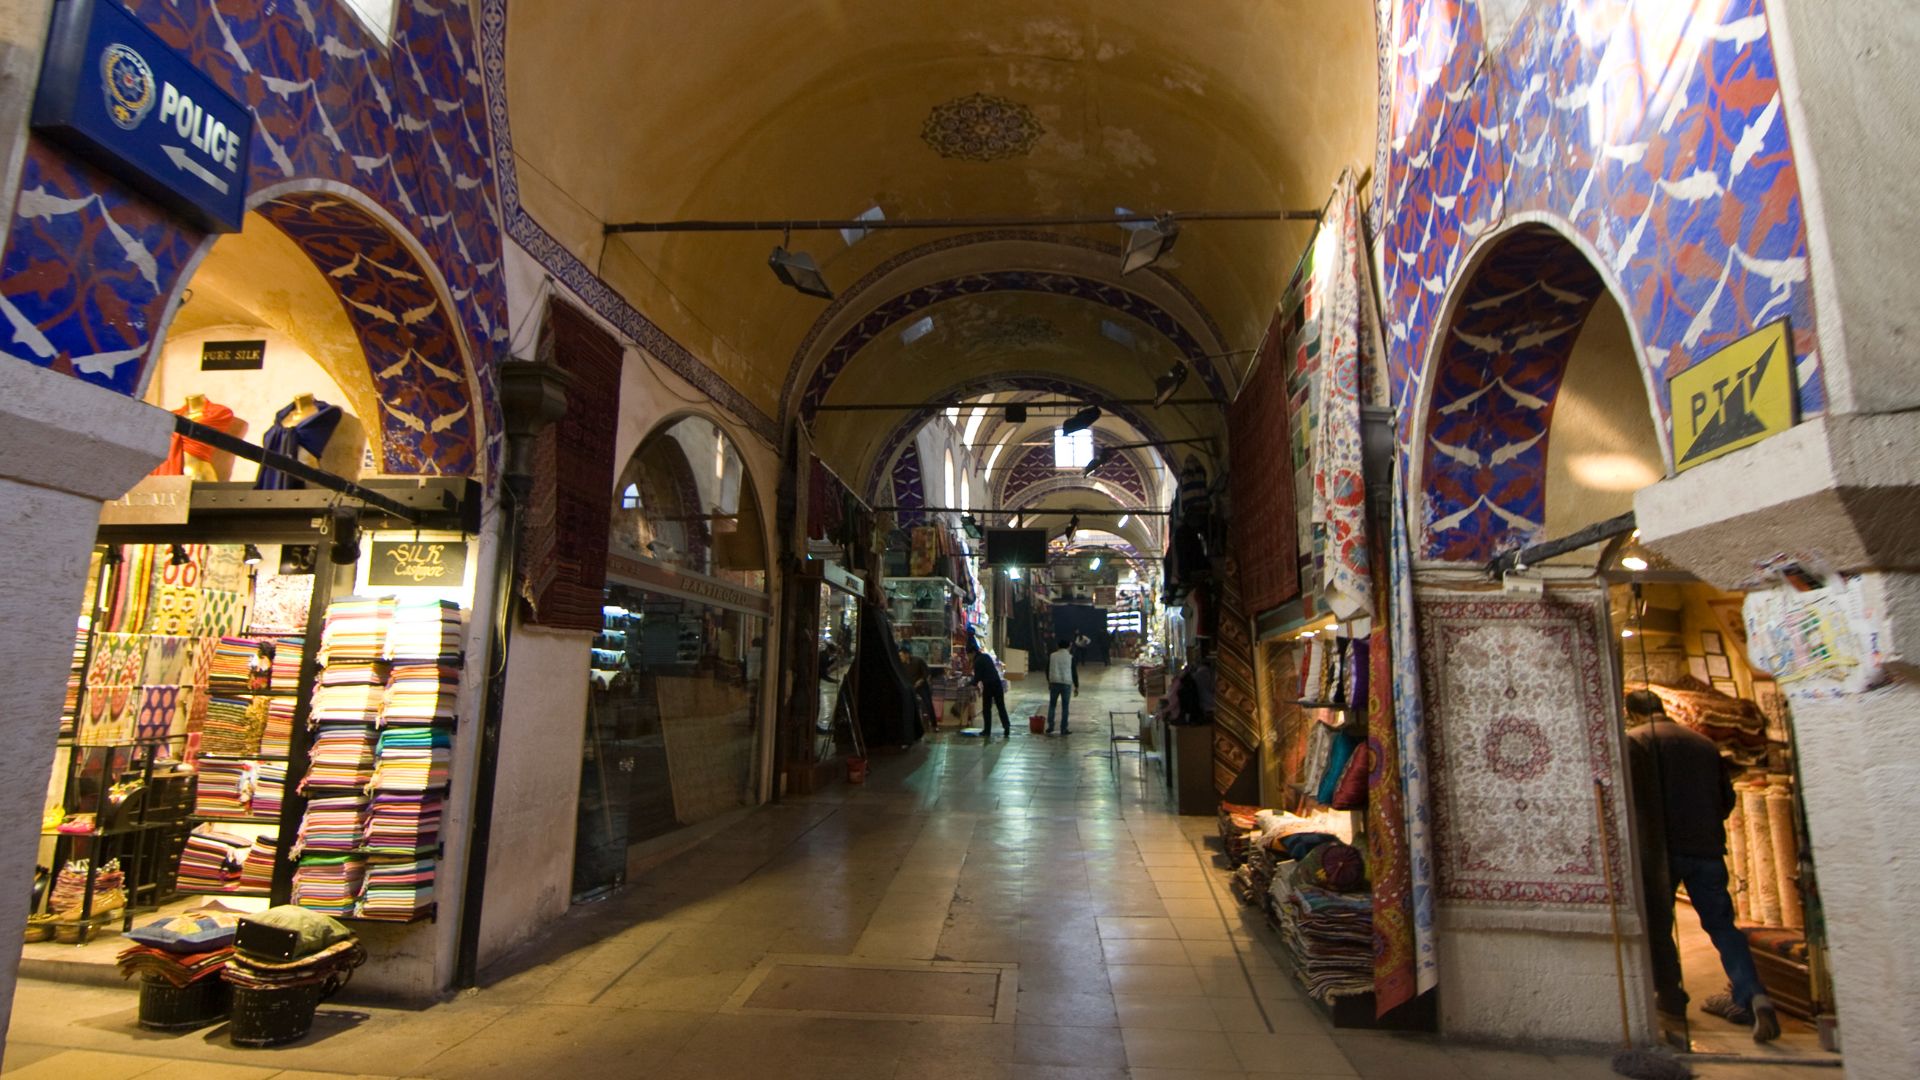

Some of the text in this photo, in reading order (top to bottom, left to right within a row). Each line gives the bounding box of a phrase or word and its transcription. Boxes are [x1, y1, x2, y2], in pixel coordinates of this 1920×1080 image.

[159, 81, 240, 173] POLICE
[204, 349, 261, 361] PURE SILK
[1690, 361, 1758, 437] PTT
[386, 543, 445, 565] SILK
